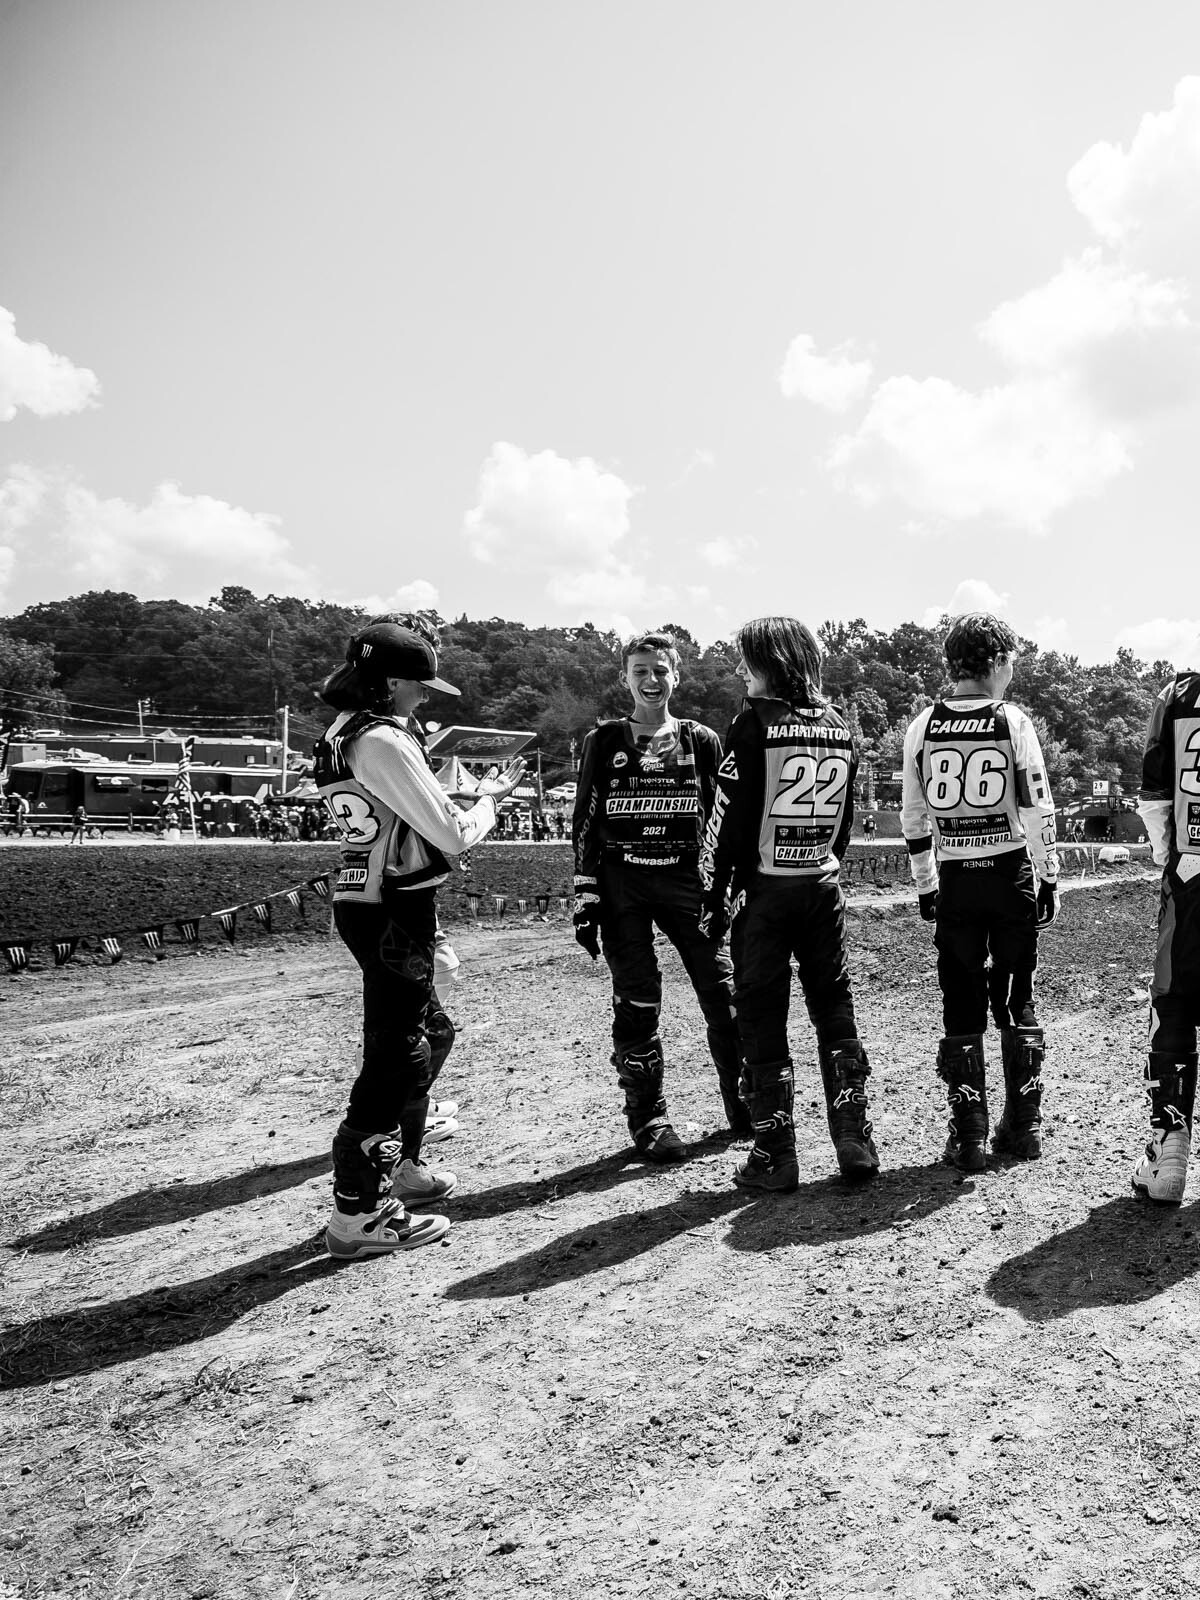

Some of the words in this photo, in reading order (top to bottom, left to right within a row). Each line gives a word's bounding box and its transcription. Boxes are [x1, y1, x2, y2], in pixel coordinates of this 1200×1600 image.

[930, 717, 995, 734] CAUDLE
[640, 777, 676, 785] MONSTER
[768, 753, 849, 819] 22
[926, 747, 1009, 811] 86
[607, 798, 698, 813] CHAMPIONSHIP
[959, 819, 988, 827] MONSTER
[642, 826, 667, 836] 2021
[941, 832, 1010, 848] CHAMPIONSHIP
[623, 852, 681, 867] Kawasaki
